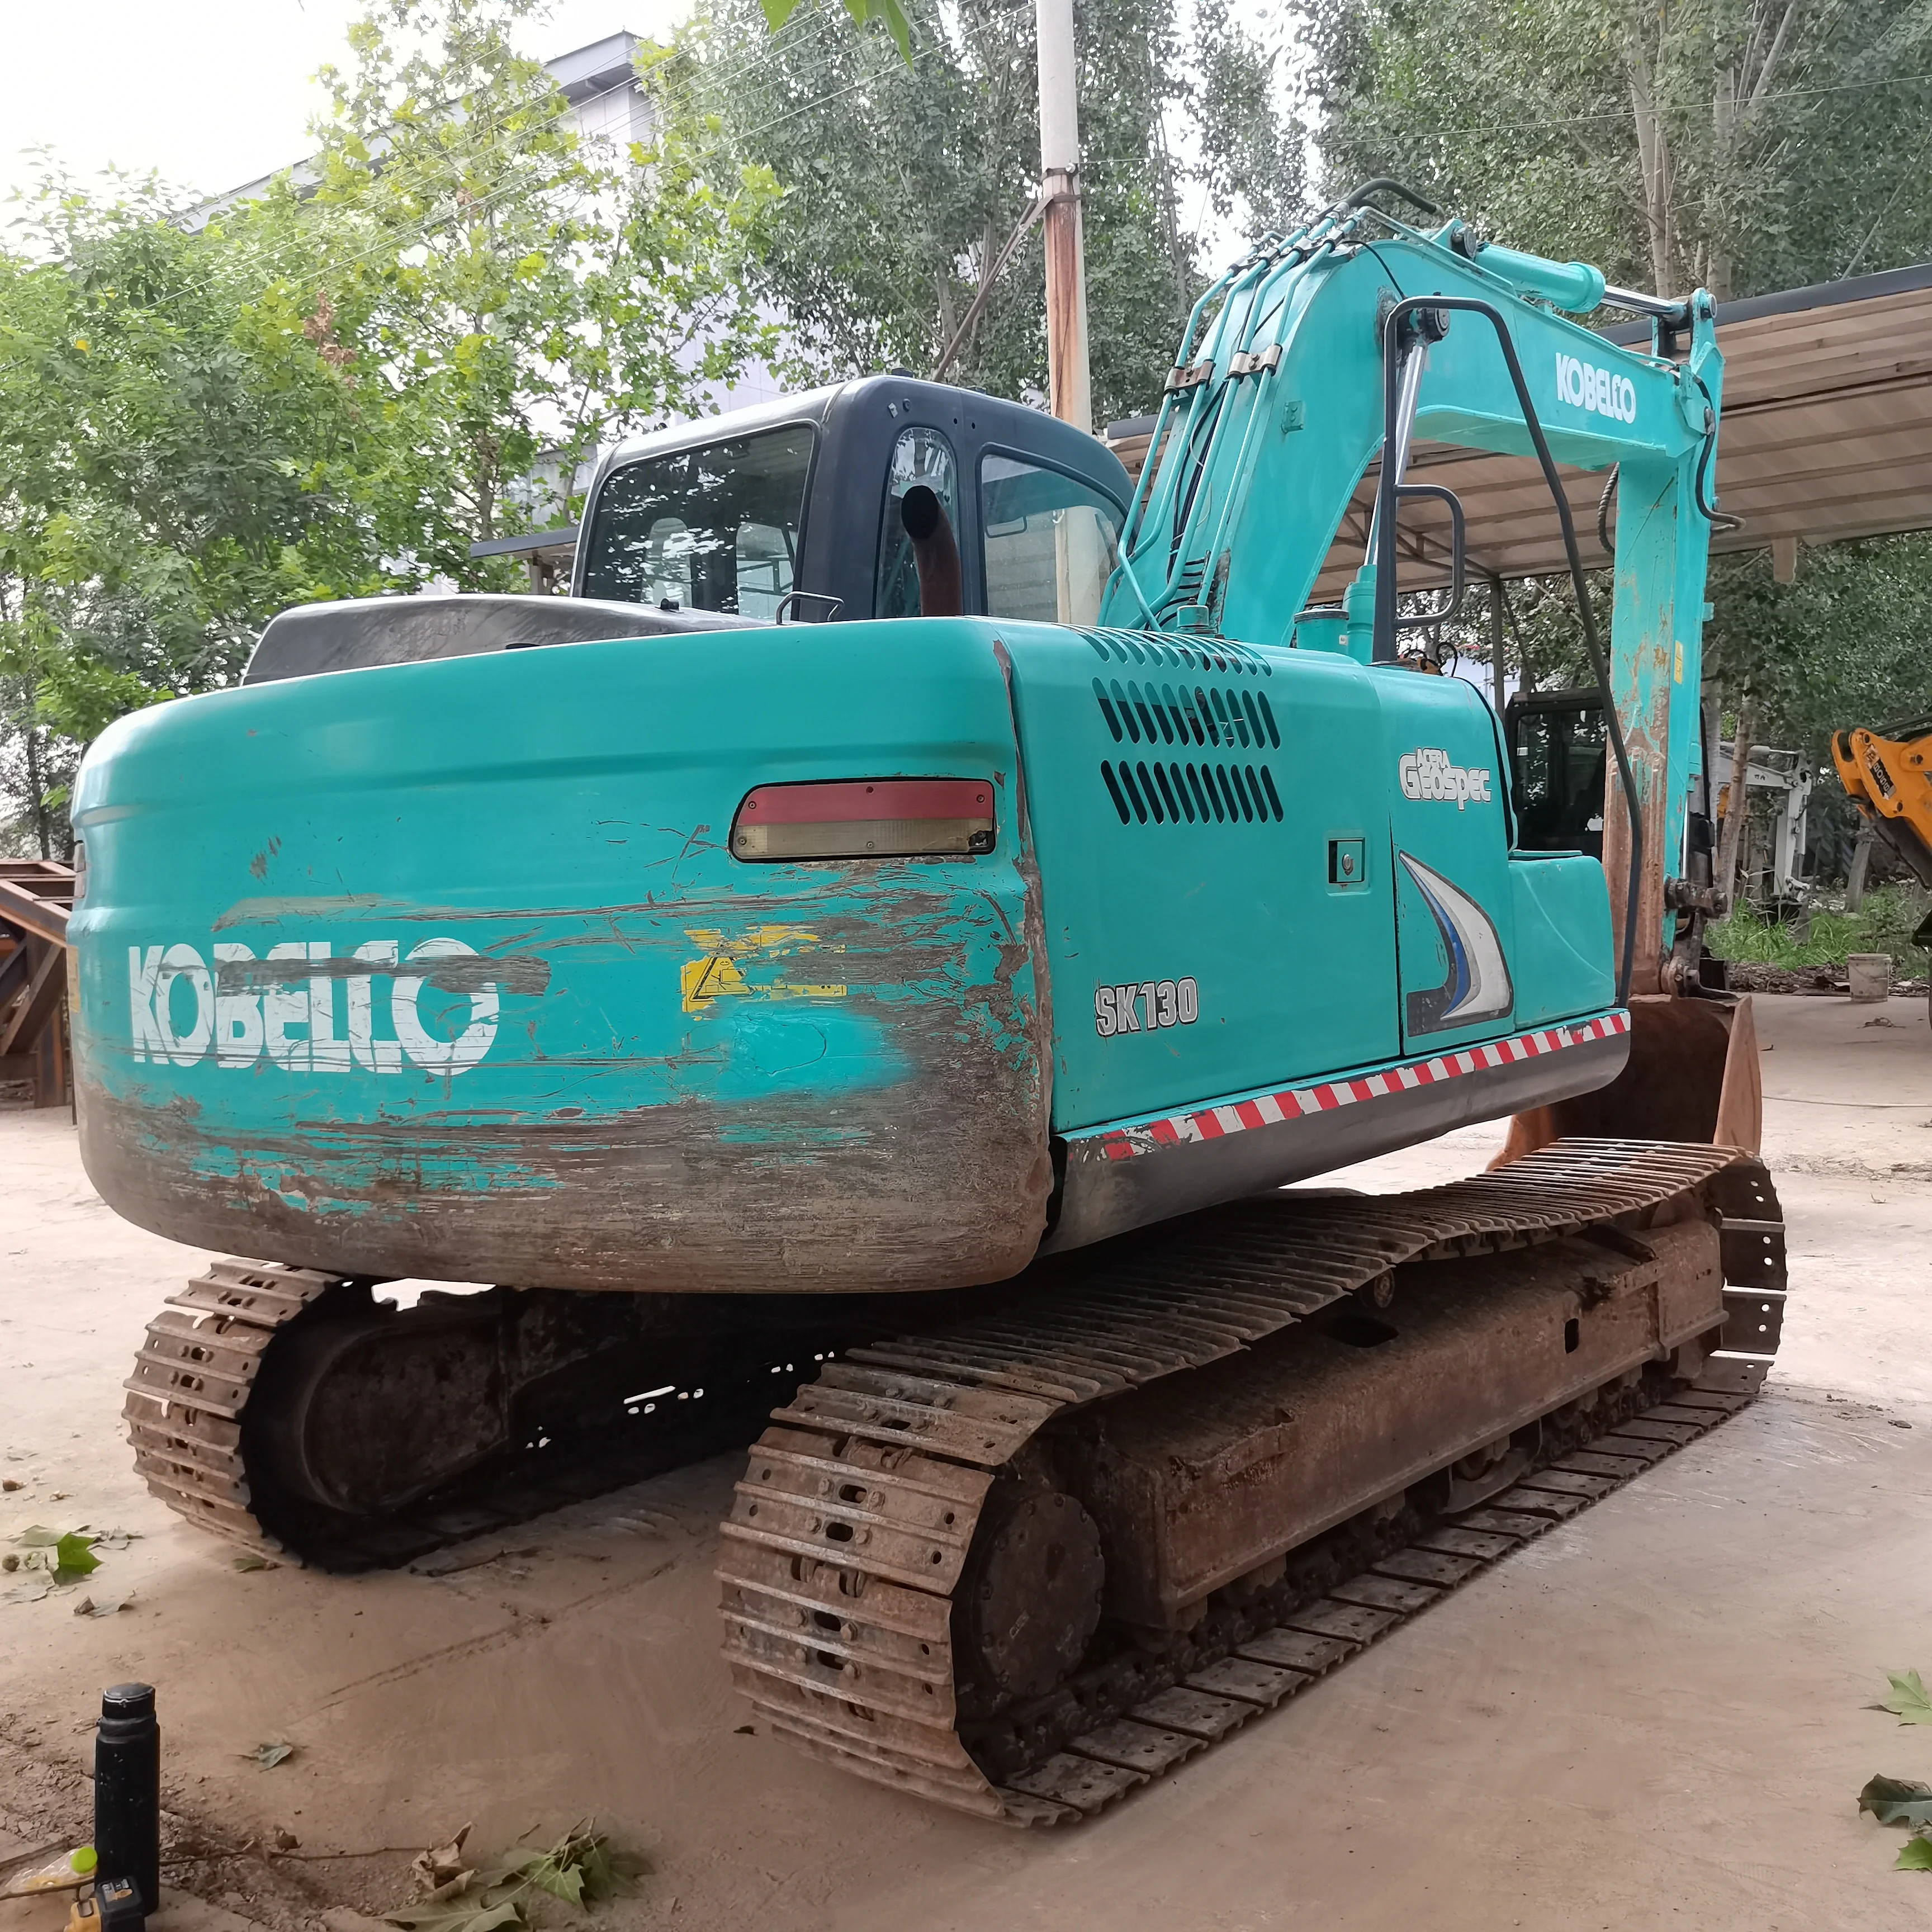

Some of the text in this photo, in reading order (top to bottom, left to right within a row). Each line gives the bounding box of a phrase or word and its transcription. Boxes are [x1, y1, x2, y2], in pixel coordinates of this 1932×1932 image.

[1555, 352, 1636, 424] KOBELCO
[128, 937, 500, 1076] KOBELCO
[1094, 976, 1199, 1038] SK130
